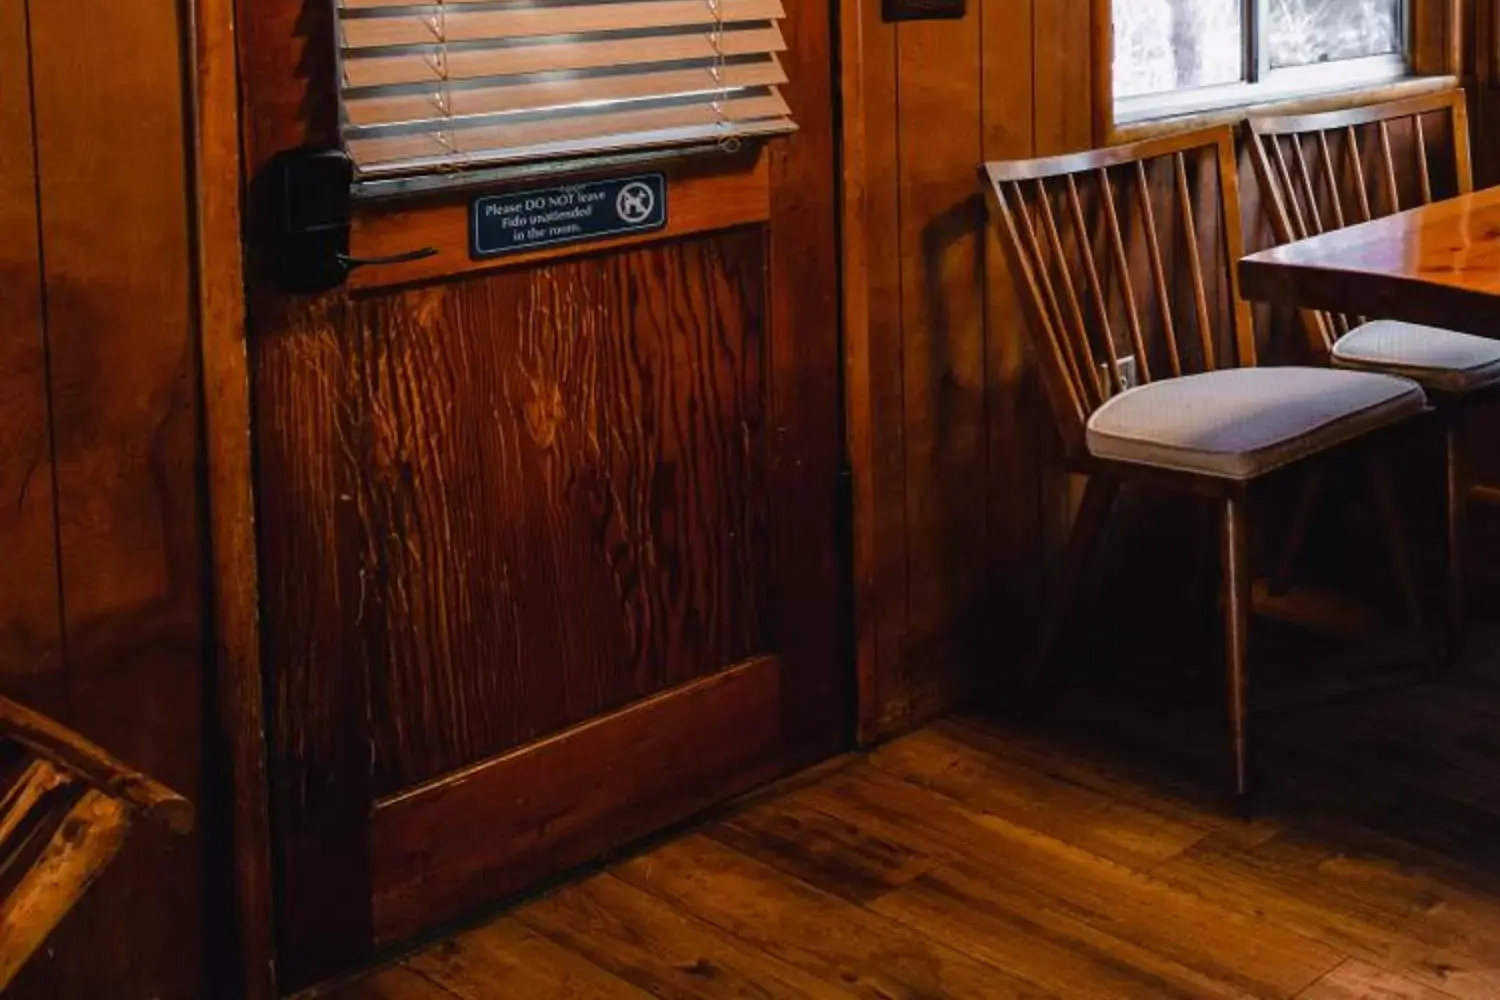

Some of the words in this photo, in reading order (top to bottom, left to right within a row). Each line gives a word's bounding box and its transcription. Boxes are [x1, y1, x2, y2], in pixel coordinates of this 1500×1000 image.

[485, 203, 522, 217] Please
[525, 197, 546, 211] DO
[548, 193, 575, 206] NOT
[577, 190, 606, 203] leave
[501, 214, 528, 229] Fido
[529, 206, 592, 224] unattended
[512, 229, 525, 242] in
[527, 227, 546, 239] the
